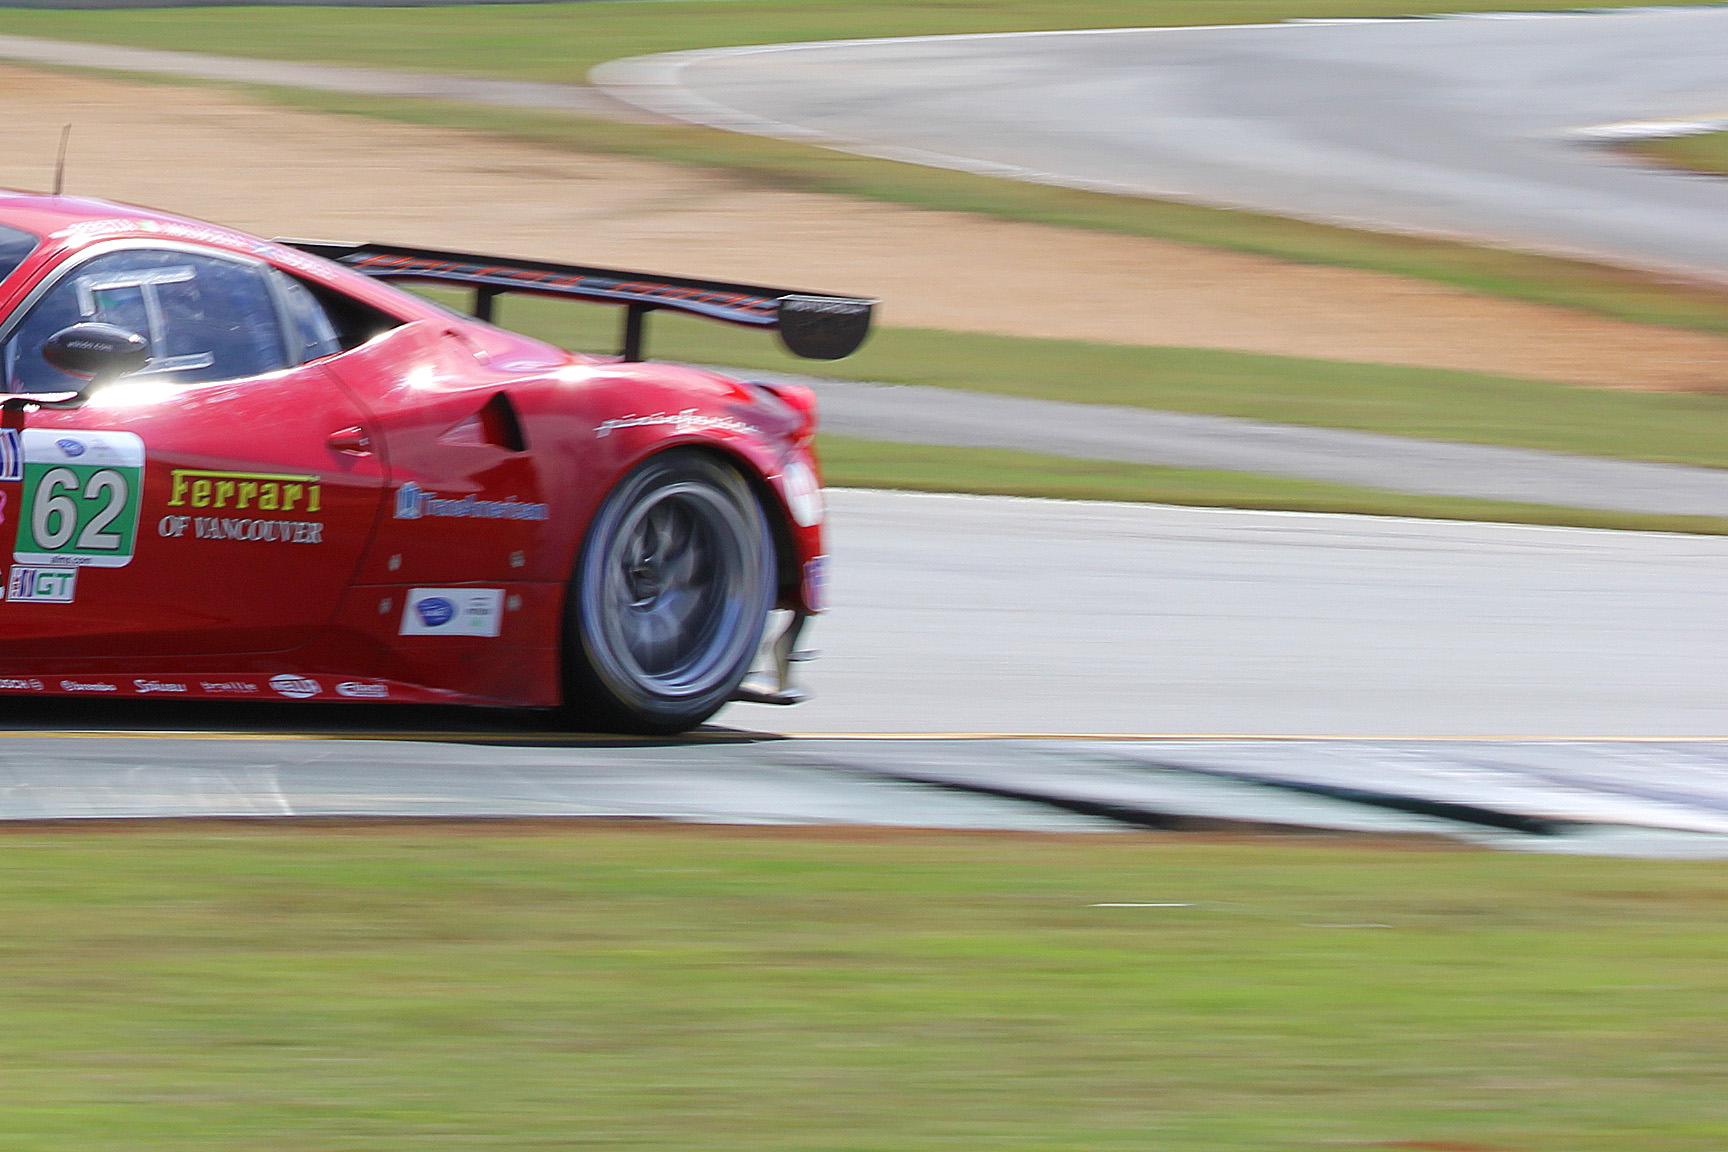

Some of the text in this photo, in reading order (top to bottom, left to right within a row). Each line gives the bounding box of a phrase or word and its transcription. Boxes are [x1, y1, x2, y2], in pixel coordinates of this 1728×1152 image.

[31, 466, 129, 550] 62
[167, 468, 321, 512] Ferrari
[158, 514, 324, 544] OF VANCOUVER
[36, 572, 73, 595] GT
